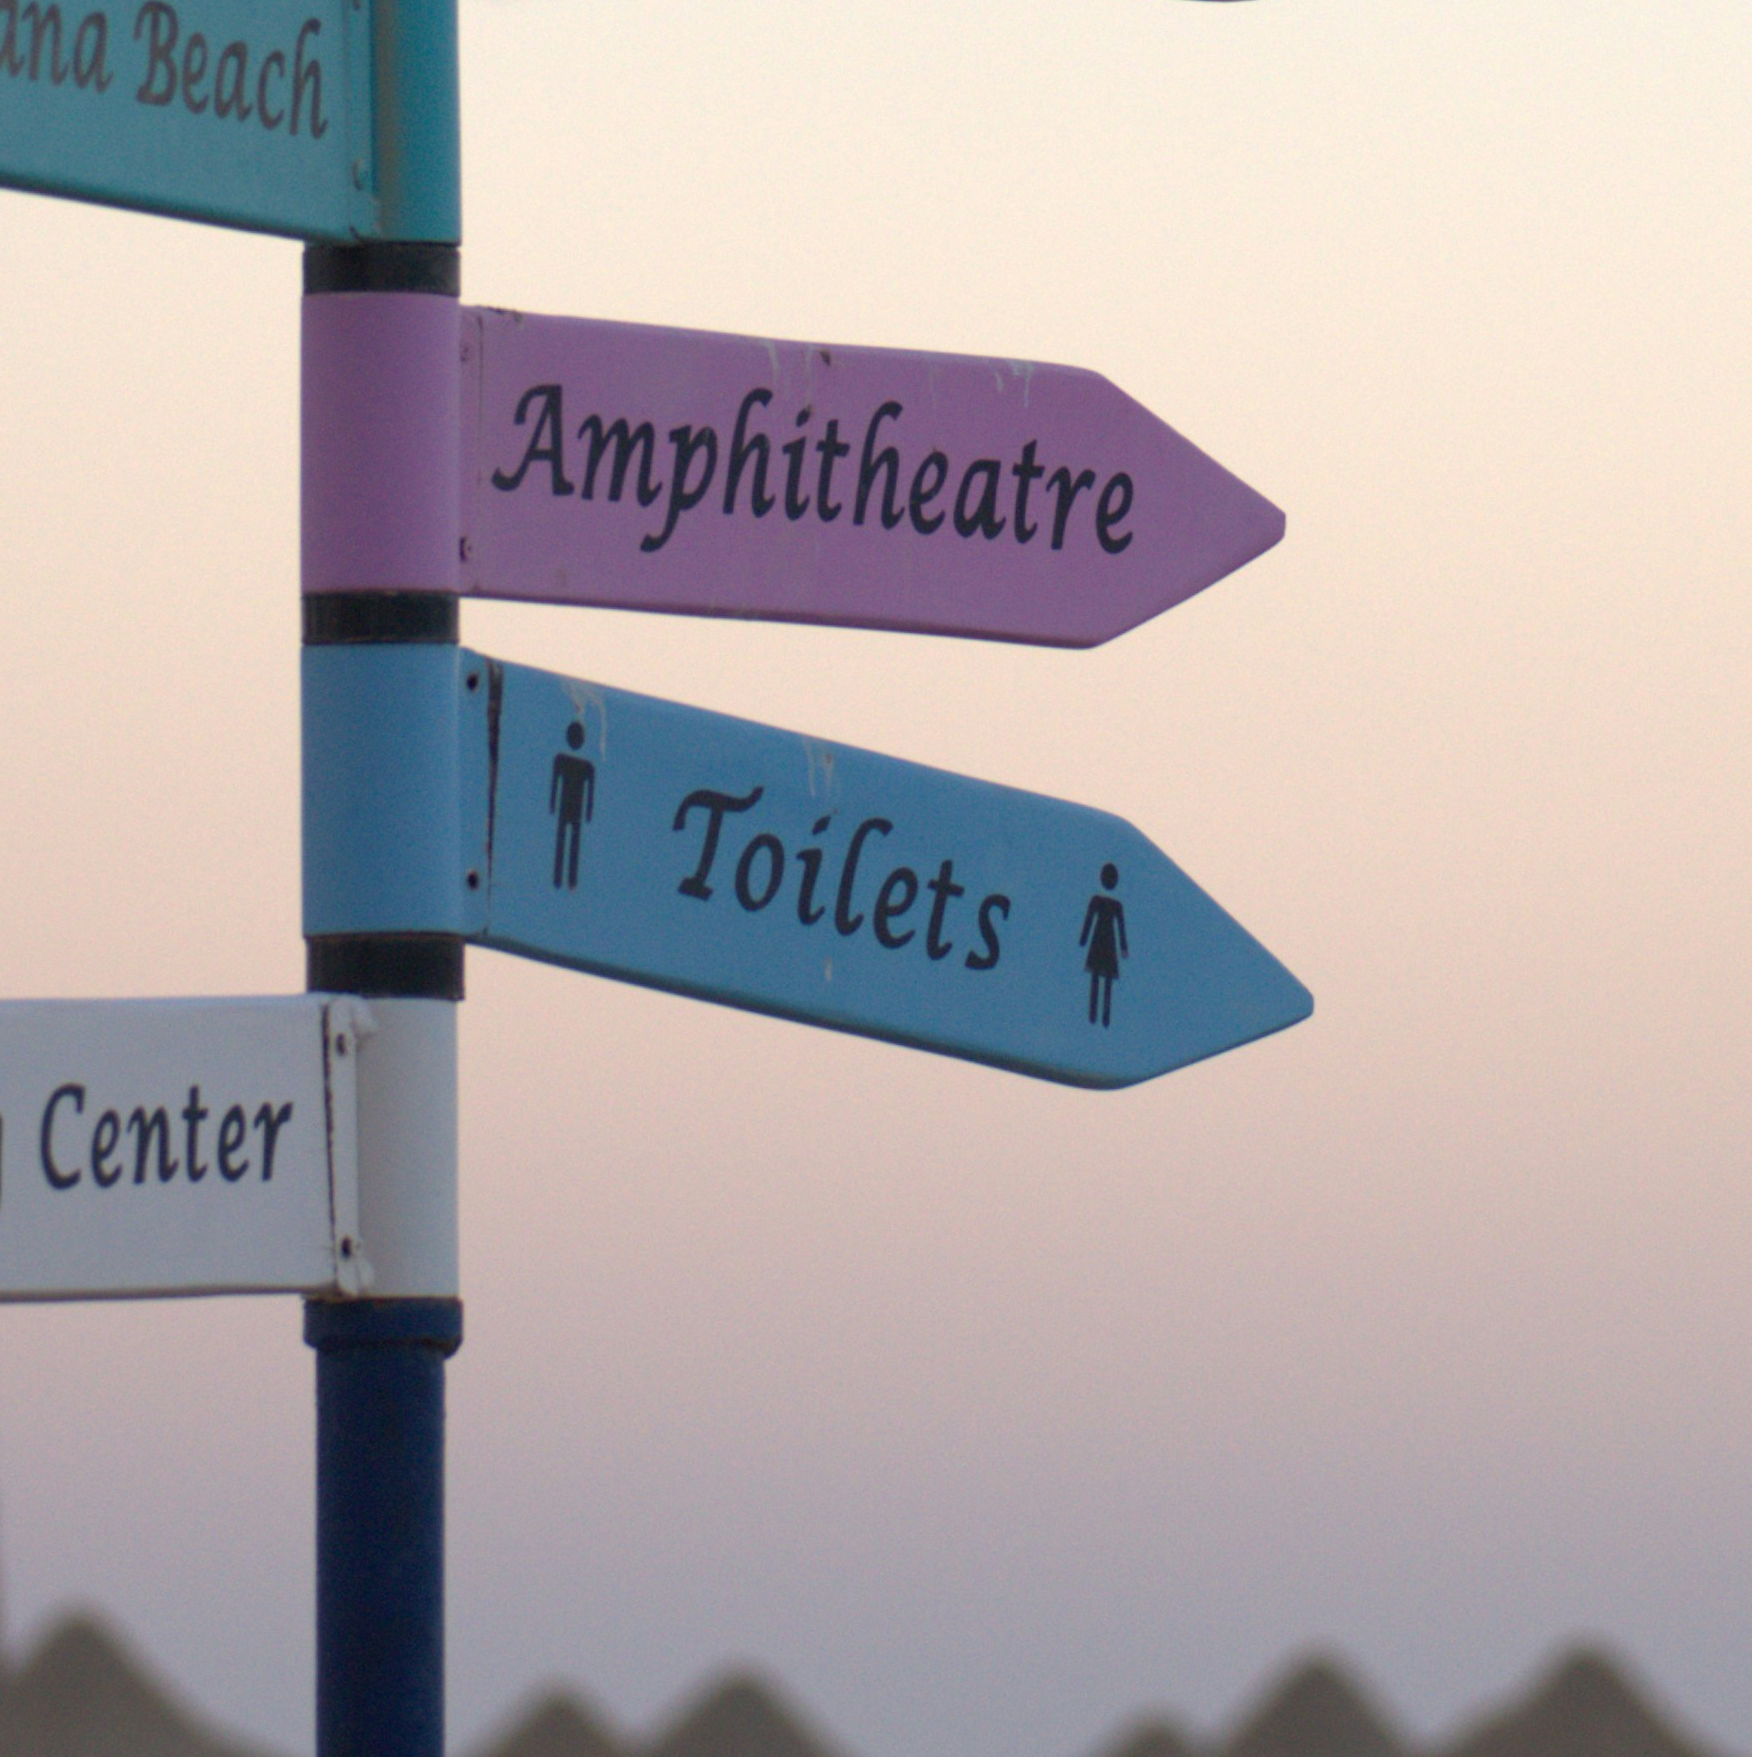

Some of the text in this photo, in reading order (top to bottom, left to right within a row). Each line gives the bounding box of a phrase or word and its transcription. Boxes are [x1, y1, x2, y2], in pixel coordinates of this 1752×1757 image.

[134, 0, 329, 139] Beach
[492, 384, 1133, 553] Amphitheatre
[673, 786, 1011, 970] Toilets
[40, 1083, 293, 1189] Center
